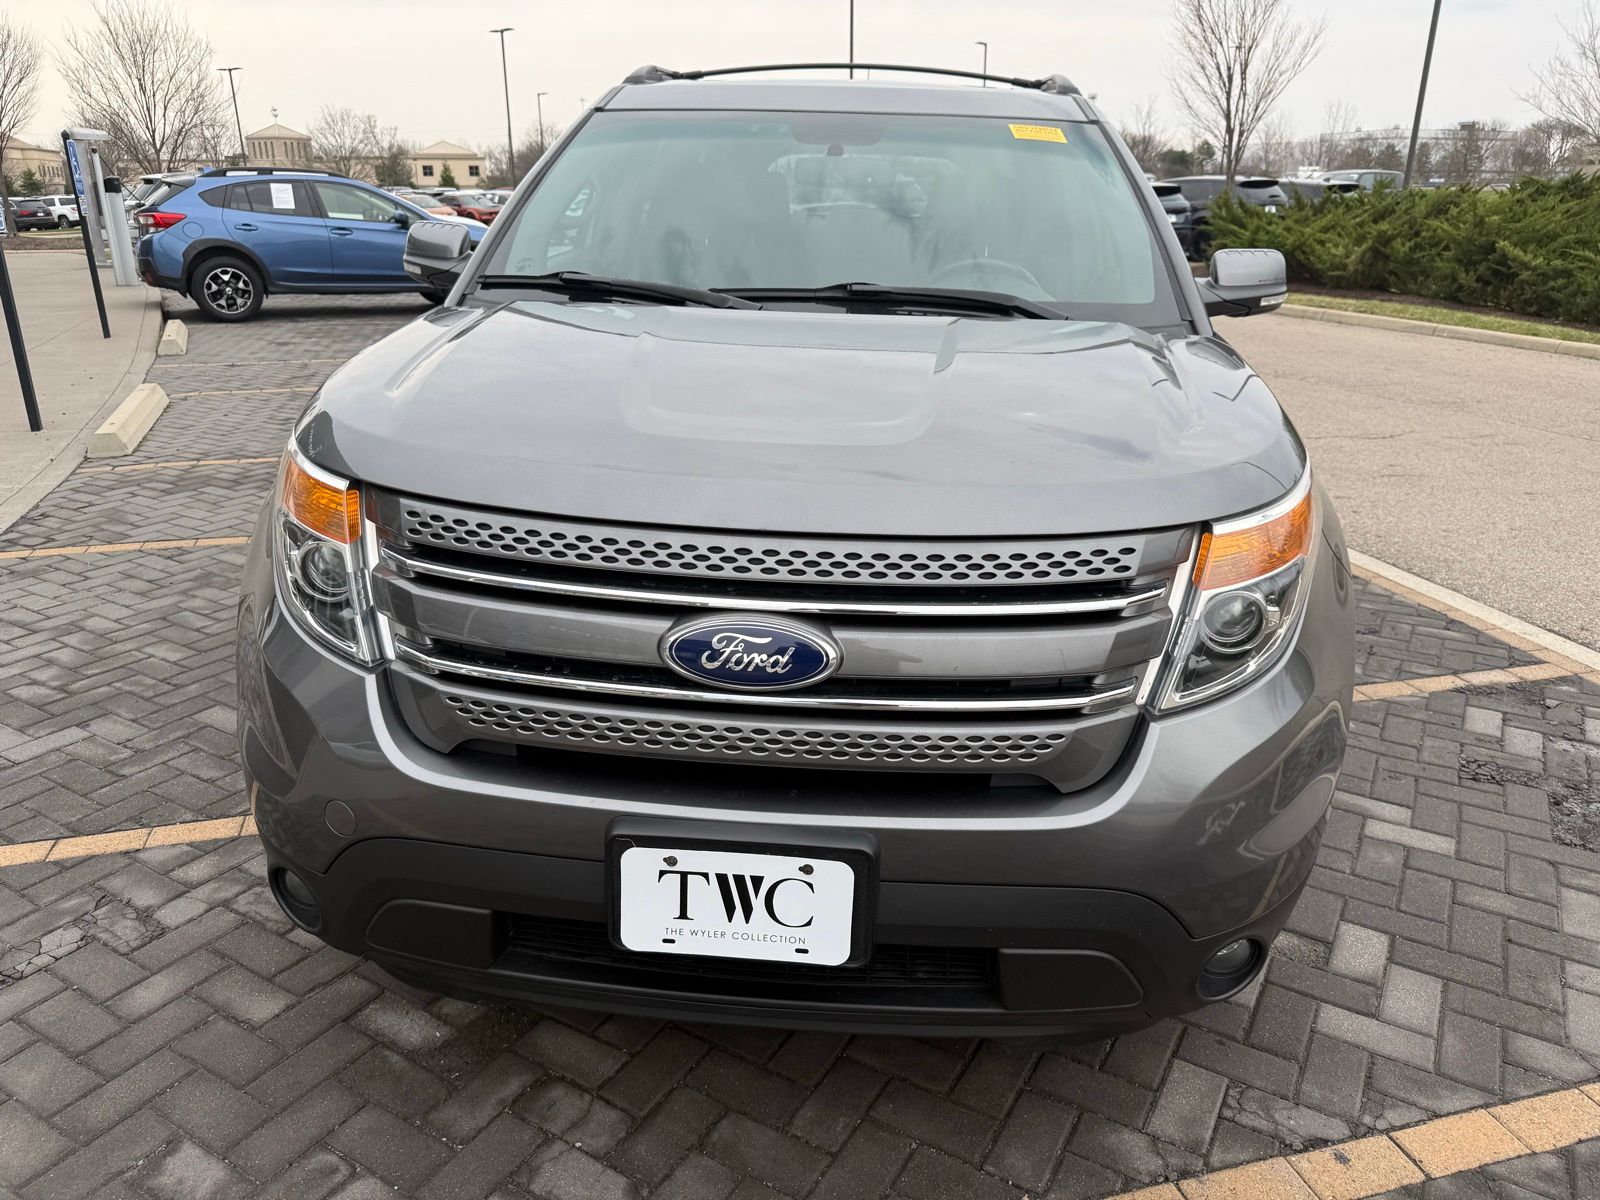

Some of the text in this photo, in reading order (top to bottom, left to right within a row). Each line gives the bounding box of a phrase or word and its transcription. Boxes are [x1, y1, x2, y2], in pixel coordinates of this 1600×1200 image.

[701, 632, 795, 674] Ford
[657, 869, 815, 928] TWC
[664, 927, 806, 945] THE WYLER COLLECTION
